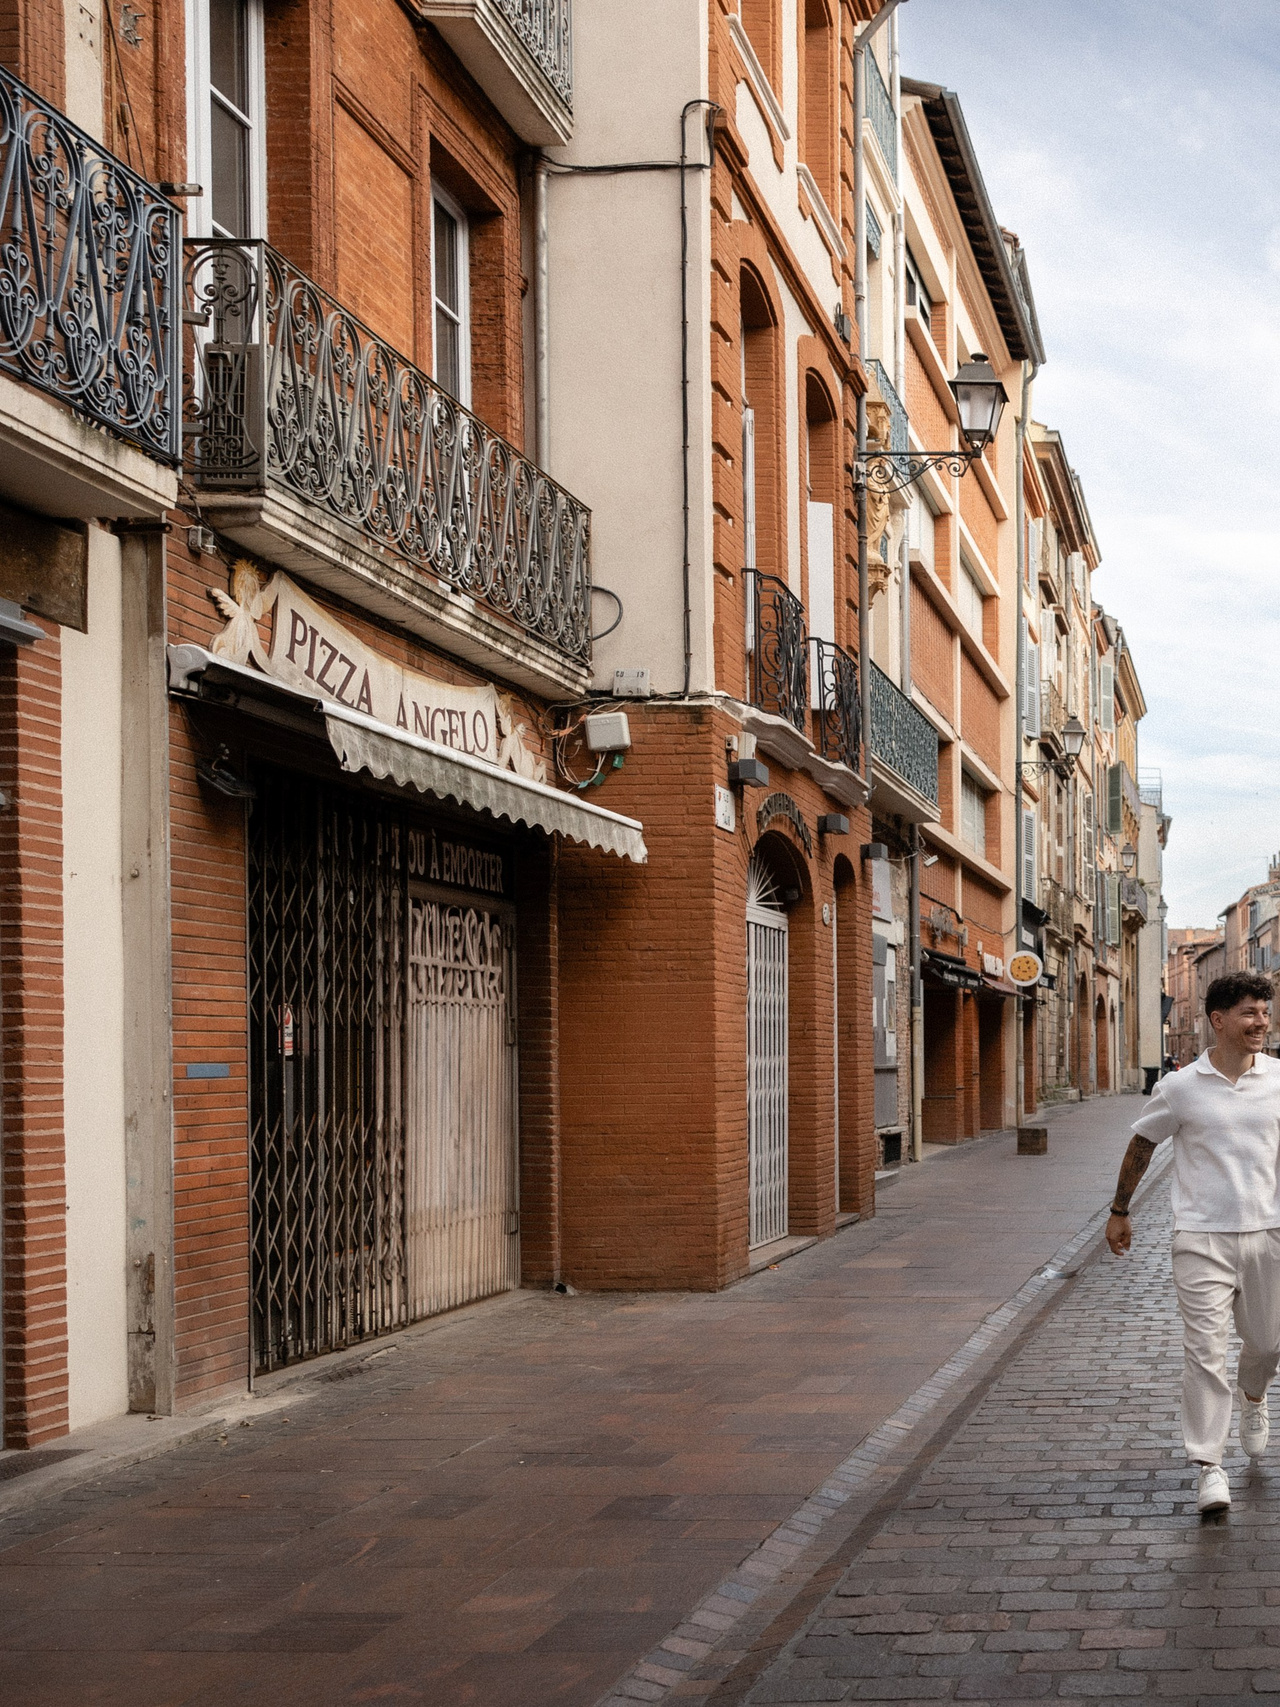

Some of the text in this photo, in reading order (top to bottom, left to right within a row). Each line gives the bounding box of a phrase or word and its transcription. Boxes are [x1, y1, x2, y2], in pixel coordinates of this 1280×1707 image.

[285, 608, 490, 753] PIZZA ANGELO
[408, 830, 426, 876] OU
[429, 828, 440, 880] À
[442, 841, 504, 894] EMPORTER
